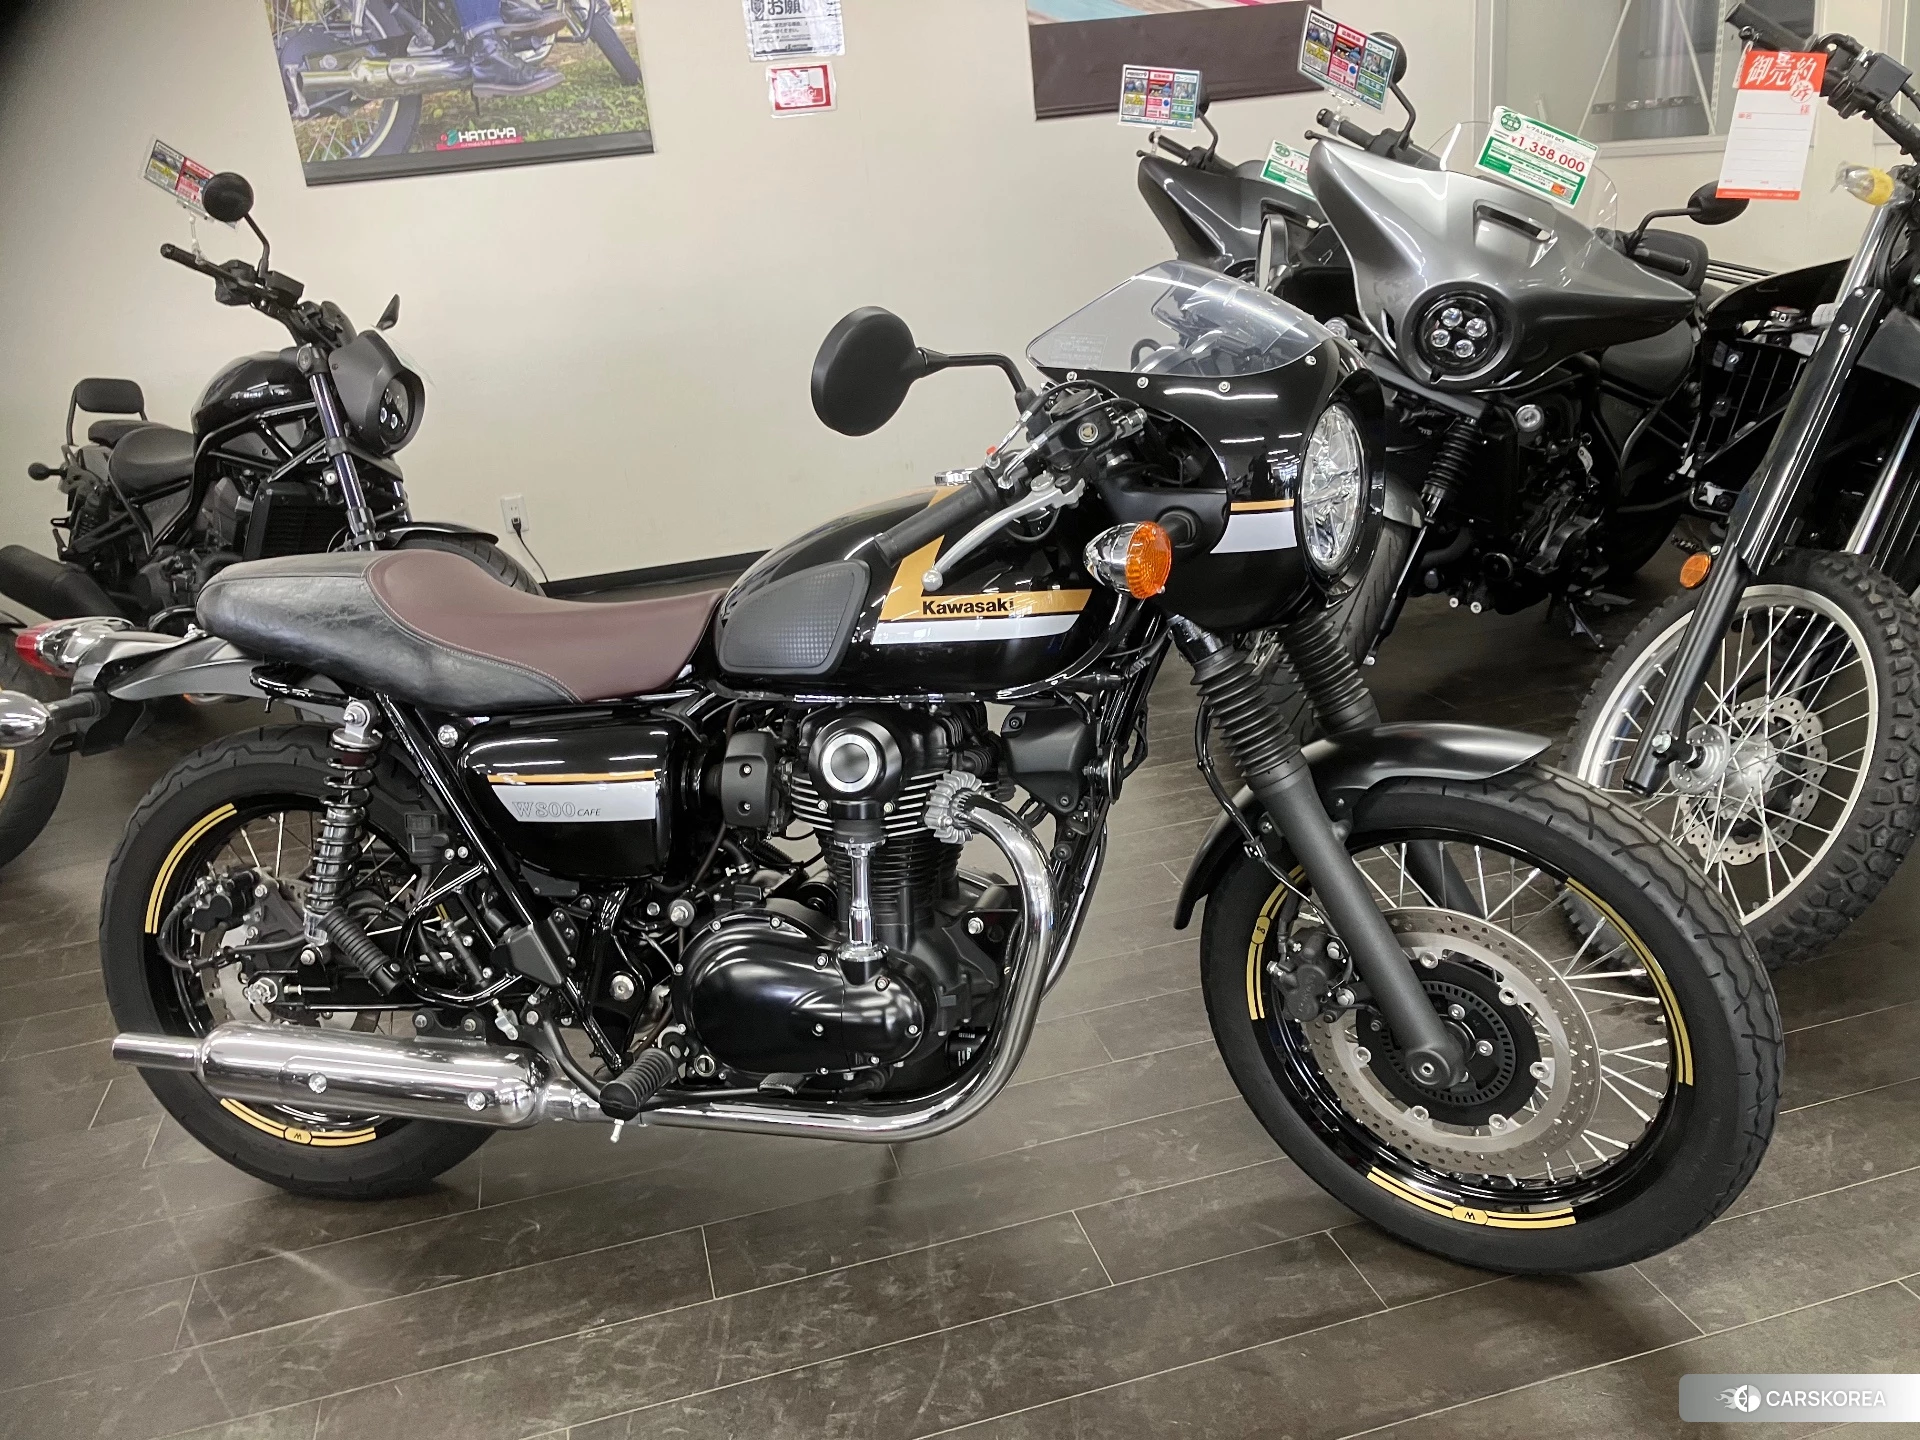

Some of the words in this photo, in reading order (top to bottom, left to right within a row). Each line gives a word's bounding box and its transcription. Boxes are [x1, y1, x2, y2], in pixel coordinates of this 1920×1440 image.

[458, 127, 517, 142] HATOYA
[922, 597, 1015, 615] Kawasaki
[511, 801, 576, 818] W800
[577, 808, 602, 817] CAFE
